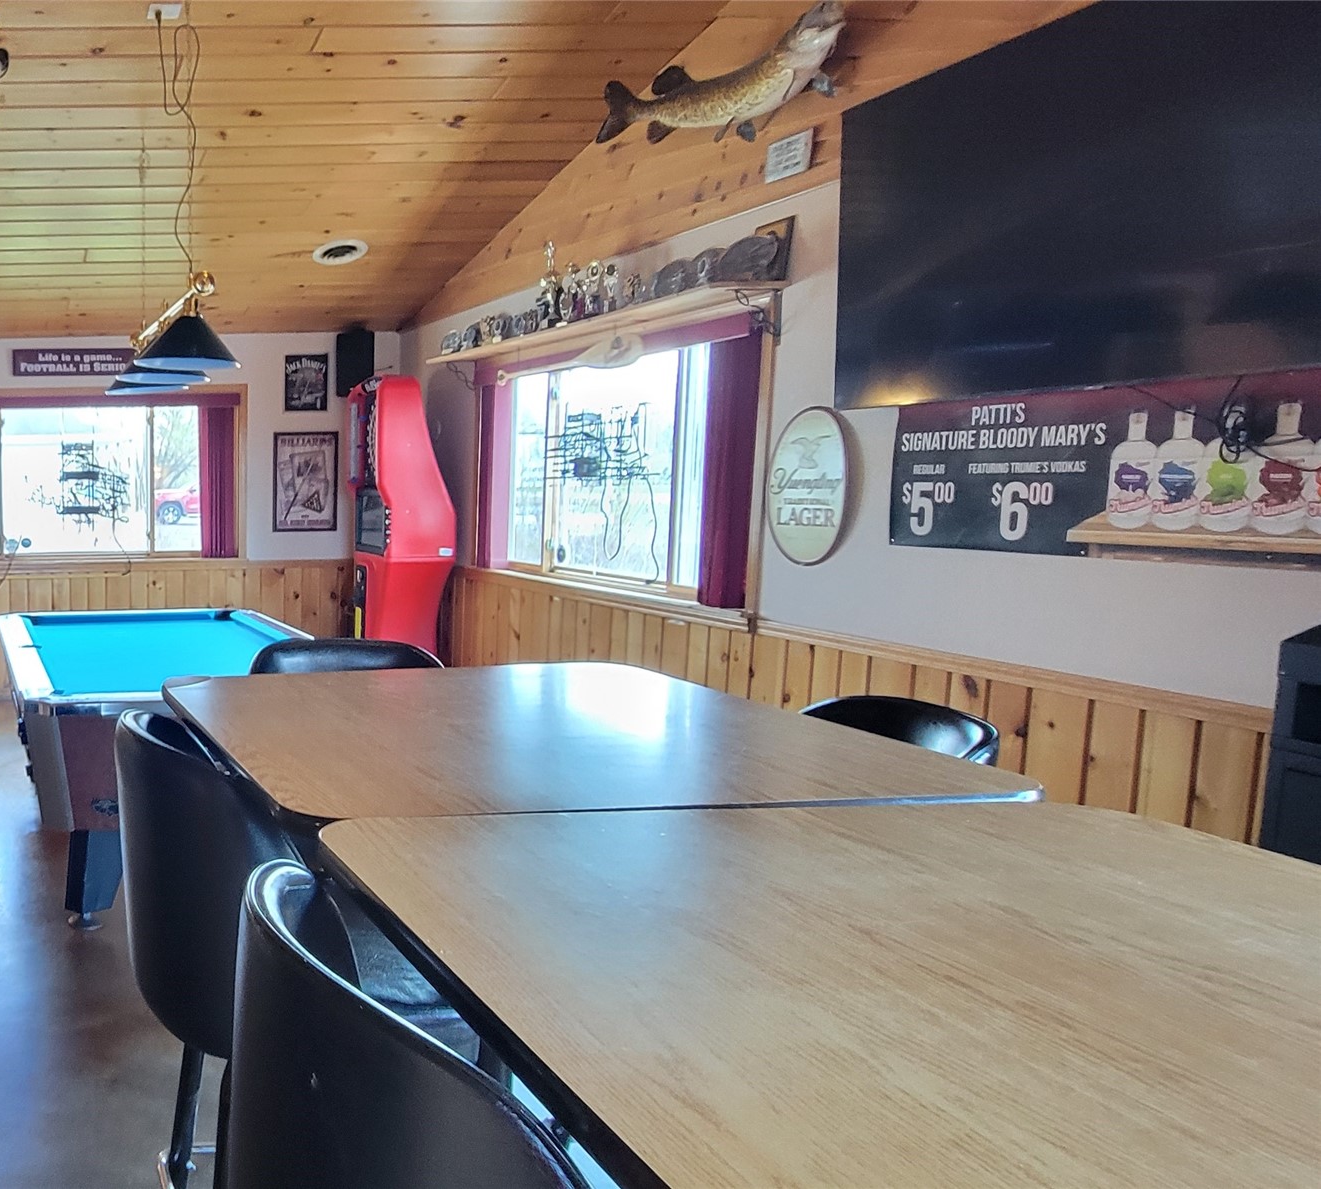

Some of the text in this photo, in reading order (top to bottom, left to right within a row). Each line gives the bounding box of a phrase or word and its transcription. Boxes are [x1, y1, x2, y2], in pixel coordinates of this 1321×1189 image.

[19, 362, 76, 372] FOOTBALL
[93, 362, 126, 372] SERIO
[38, 353, 58, 362] Life
[971, 402, 1026, 426] PATTI'S
[901, 422, 1107, 452] SIGNATURE BLOODY MARY'S
[912, 463, 946, 475] REGULAR
[968, 461, 1009, 475] FEATURING
[1050, 460, 1087, 473] VODKAS
[769, 467, 843, 496] Yuengling
[776, 507, 836, 527] LAGER
